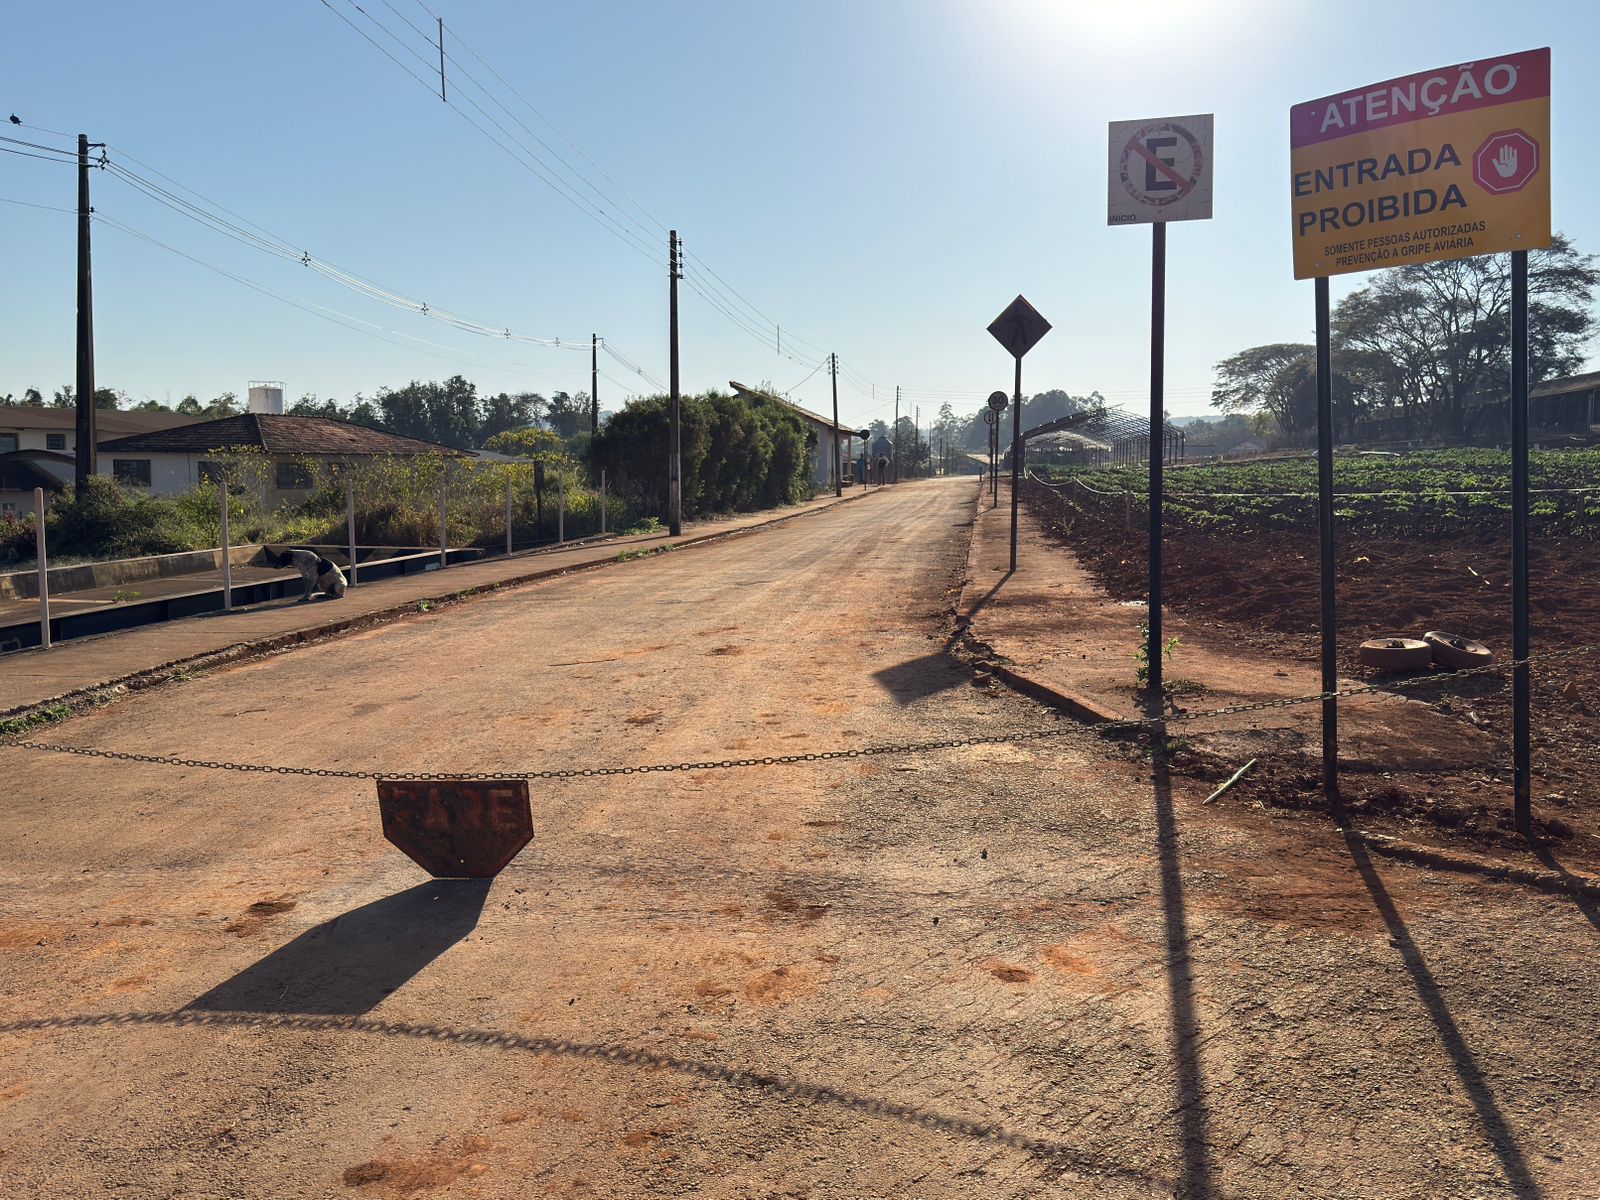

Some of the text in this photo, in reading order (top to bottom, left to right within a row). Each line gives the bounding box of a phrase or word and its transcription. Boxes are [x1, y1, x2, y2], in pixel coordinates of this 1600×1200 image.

[1320, 63, 1517, 133] ATENÇÃO
[1146, 137, 1177, 191] E
[1294, 143, 1461, 197] ENTRADA
[1299, 183, 1467, 236] PROIBIDA
[1324, 220, 1486, 256] SOMENTE PESSOAS AUTORIZADAS
[1336, 248, 1389, 267] PREVENÇÃO
[1401, 243, 1430, 256] GRIPE
[1433, 236, 1474, 252] AVIÁRIA
